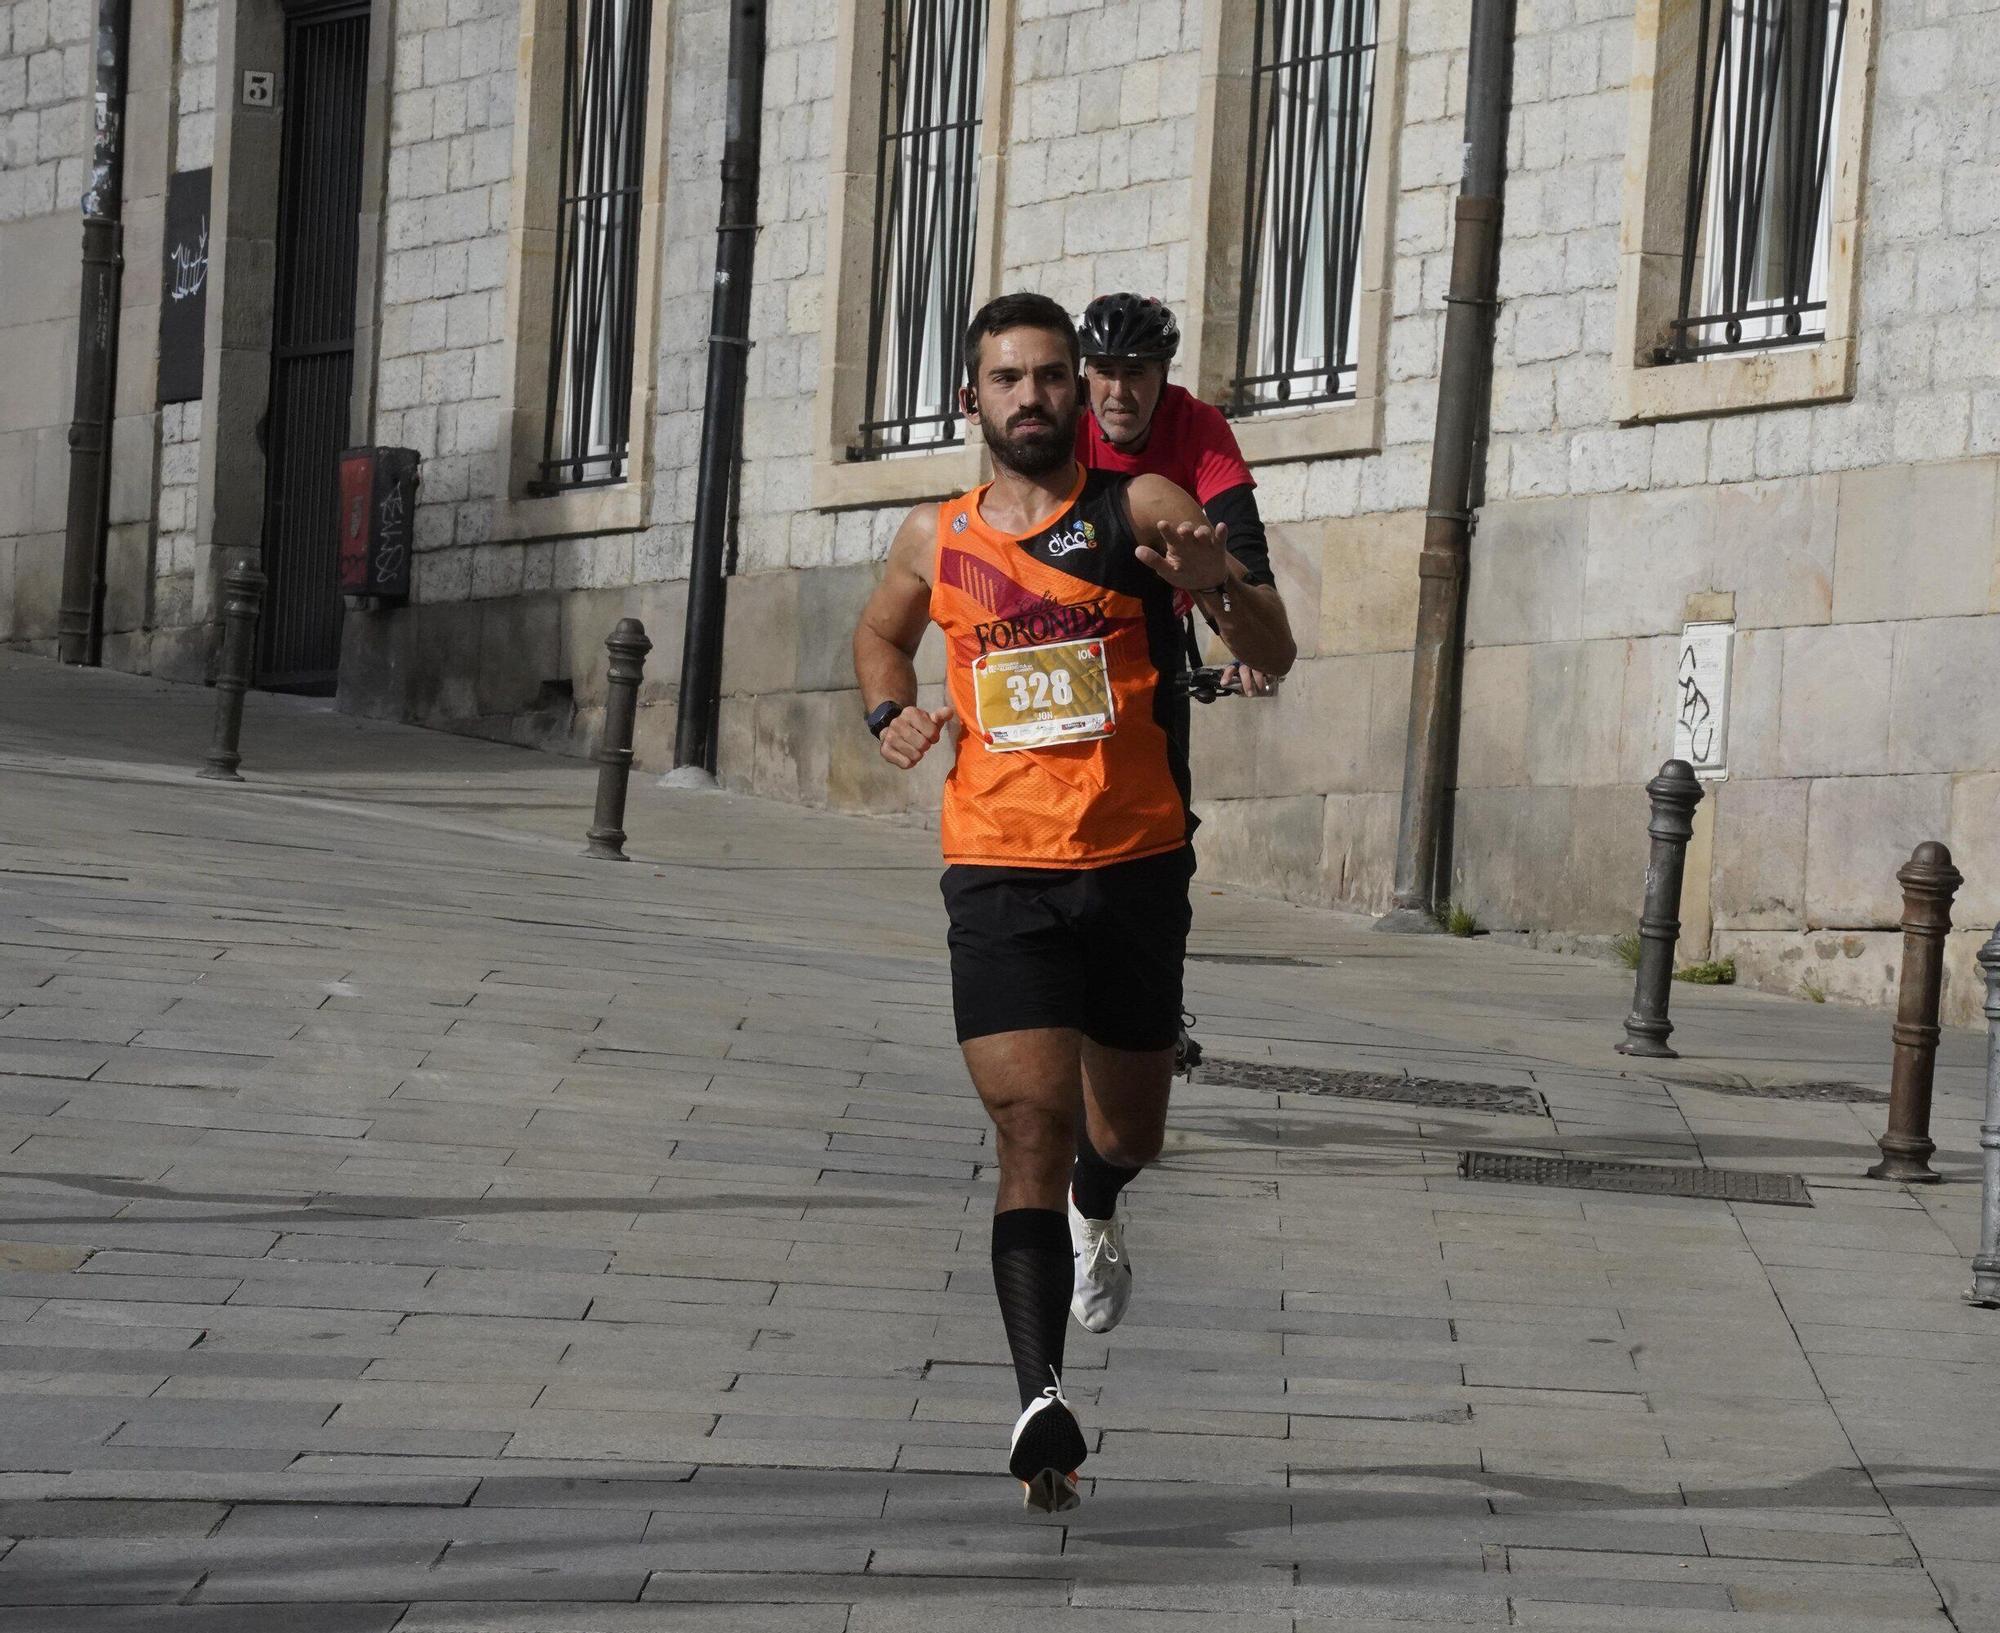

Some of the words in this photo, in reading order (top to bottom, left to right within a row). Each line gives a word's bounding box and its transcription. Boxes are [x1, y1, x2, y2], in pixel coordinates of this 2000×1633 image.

[249, 76, 268, 100] 5
[974, 601, 1107, 655] FORONDA
[1006, 669, 1073, 712] 328
[1036, 711, 1053, 721] JON
